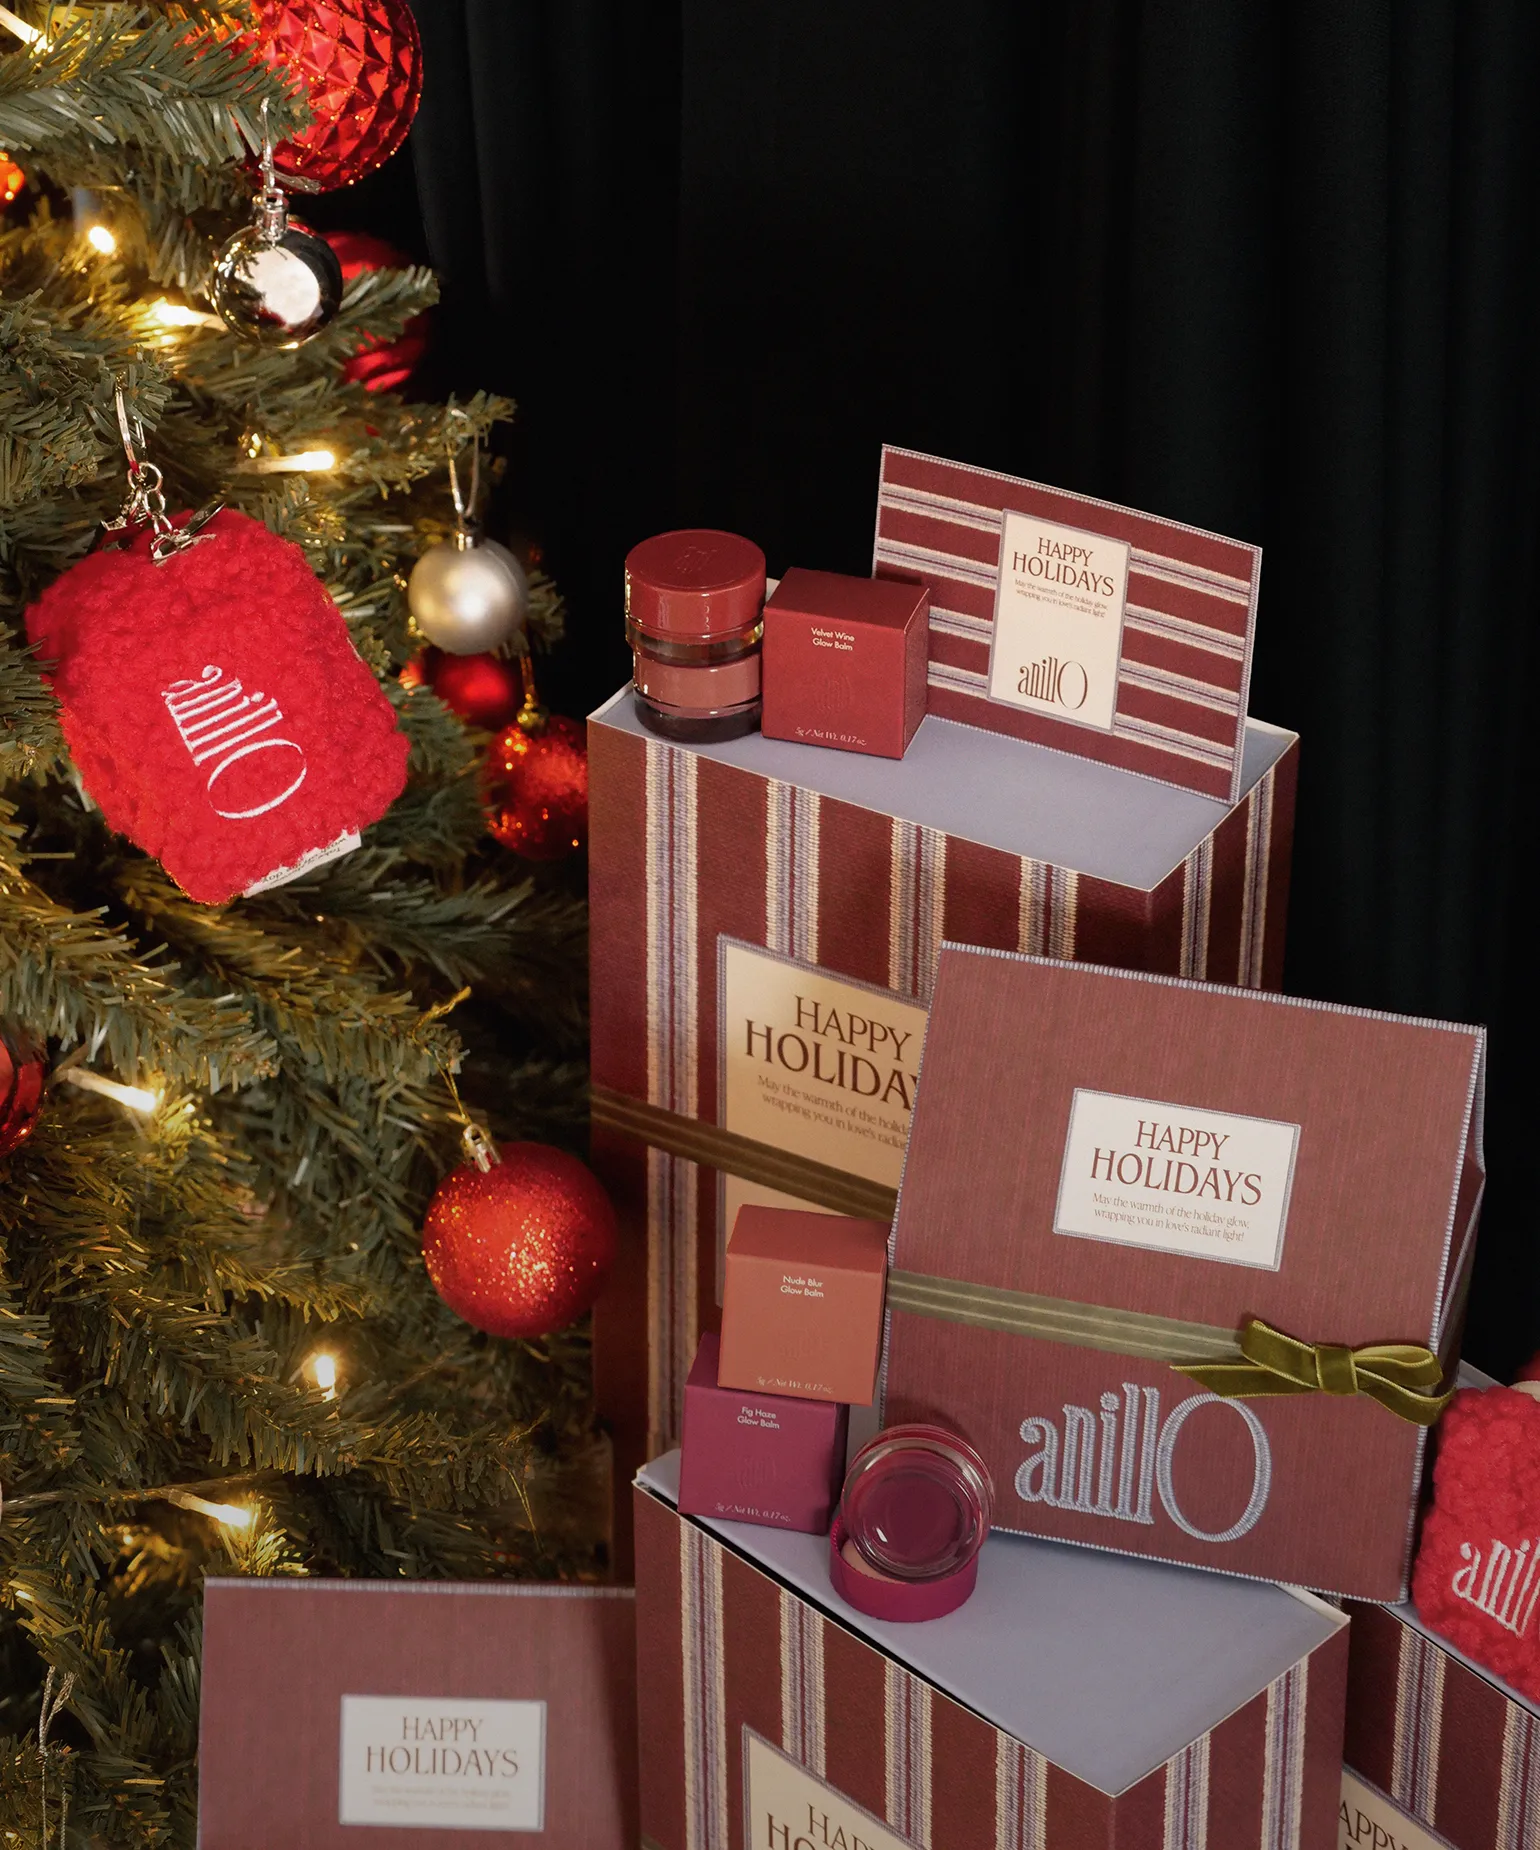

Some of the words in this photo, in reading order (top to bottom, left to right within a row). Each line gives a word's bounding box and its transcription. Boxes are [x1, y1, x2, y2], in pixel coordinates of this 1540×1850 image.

[1037, 537, 1094, 567] HAPPY
[1012, 551, 1114, 597] HOLIDAYS
[811, 627, 833, 638] Velvet
[834, 631, 854, 642] Wine
[813, 638, 833, 648] Glow
[834, 641, 852, 650] Balm
[795, 995, 912, 1062] HAPPY
[758, 1075, 780, 1093] May
[783, 1083, 800, 1097] the
[802, 1091, 843, 1113] warmth
[845, 1106, 857, 1118] of
[858, 1110, 877, 1124] the
[762, 1093, 812, 1120] wrapping
[813, 1111, 833, 1125] you
[836, 1118, 846, 1129] in
[1134, 1120, 1230, 1161] HAPPY
[1090, 1147, 1262, 1206] HOLIDAYS
[1093, 1193, 1111, 1207] May
[1113, 1196, 1128, 1208] the
[1130, 1201, 1164, 1214] warmth
[1166, 1205, 1177, 1215] of
[1177, 1207, 1192, 1218] the
[1193, 1209, 1225, 1226] holiday
[1094, 1209, 1135, 1226] wrapping
[1136, 1216, 1153, 1226] you
[1155, 1218, 1164, 1228] in
[1191, 1224, 1222, 1238] radiant
[780, 1285, 802, 1294] Glow
[804, 1288, 824, 1297] Balm
[783, 1275, 806, 1285] Nude
[808, 1278, 823, 1288] Blur
[737, 1415, 759, 1425] Glow
[760, 1418, 780, 1429] Balm
[742, 1406, 753, 1417] Fig
[755, 1408, 776, 1419] Haze
[402, 1715, 483, 1742] HAPPY
[366, 1746, 519, 1778] HOLIDAYS
